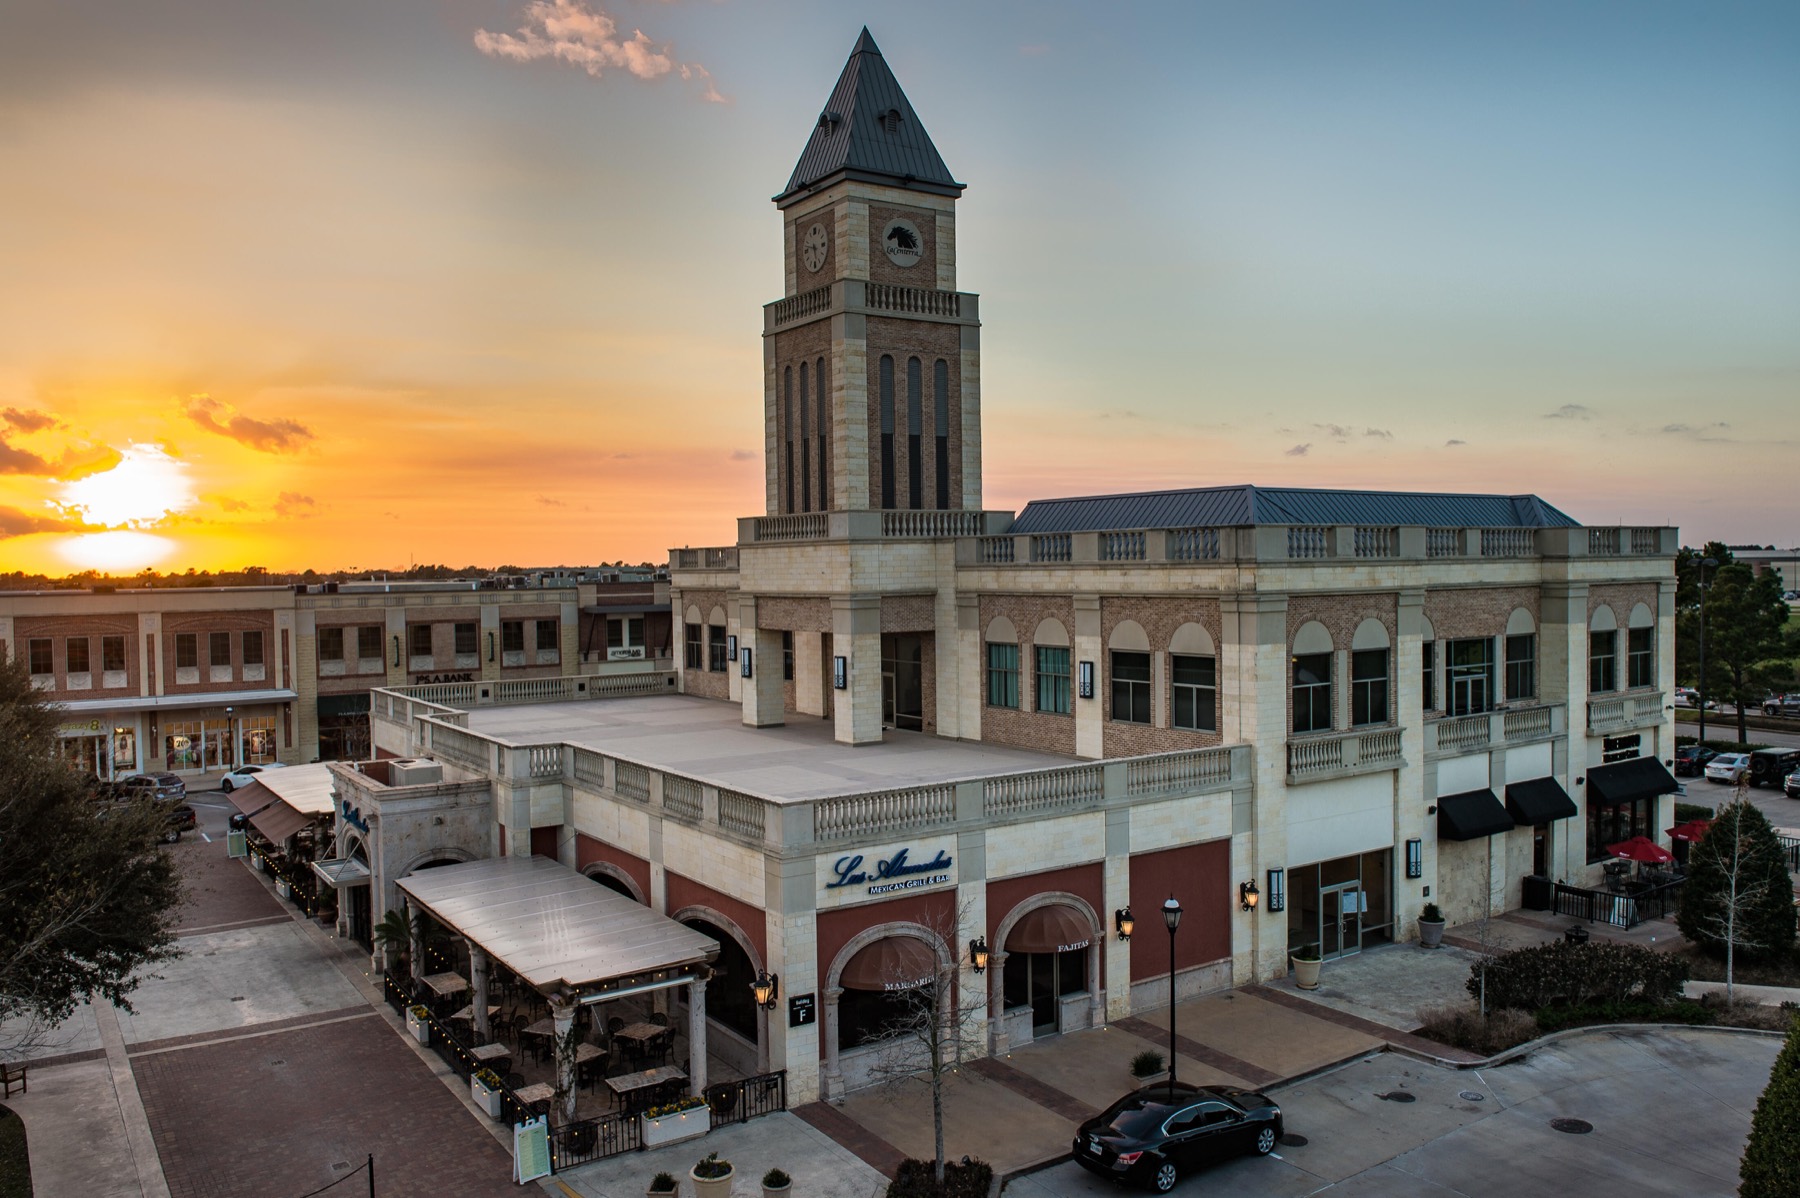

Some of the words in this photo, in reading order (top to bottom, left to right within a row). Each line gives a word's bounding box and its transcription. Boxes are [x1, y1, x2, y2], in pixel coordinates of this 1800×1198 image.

[444, 673, 474, 682] BANK
[90, 719, 100, 731] 8
[870, 883, 905, 895] MEXICAN
[905, 879, 927, 889] GRILL
[927, 876, 935, 885] &
[935, 875, 951, 883] BAR
[1058, 939, 1089, 952] FAJITAS
[800, 1009, 806, 1022] F
